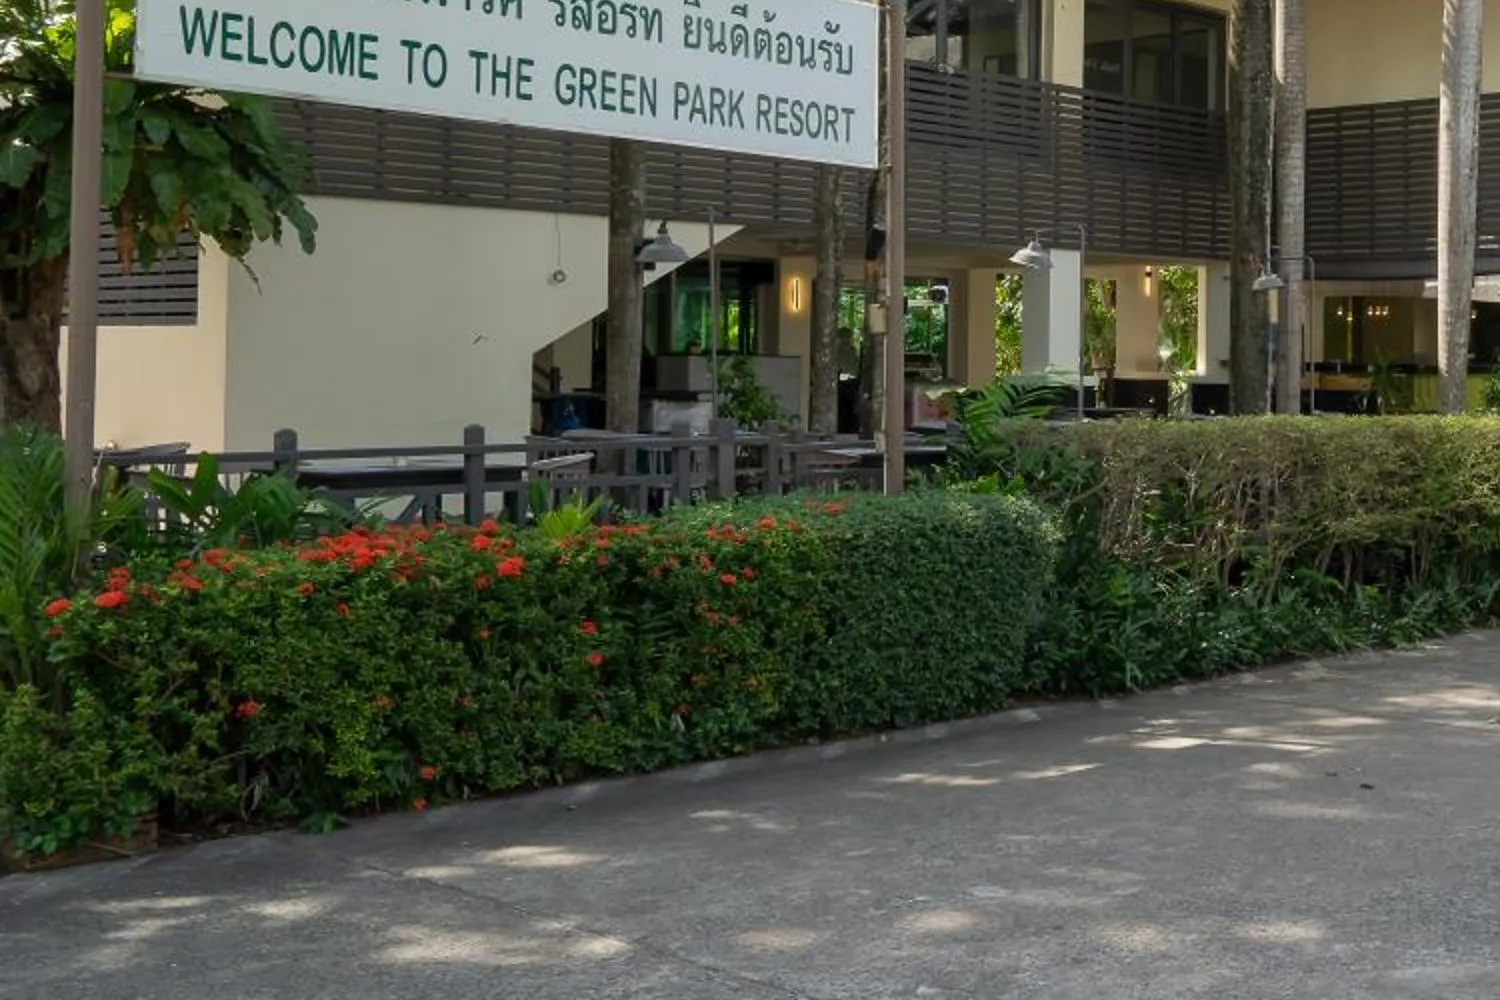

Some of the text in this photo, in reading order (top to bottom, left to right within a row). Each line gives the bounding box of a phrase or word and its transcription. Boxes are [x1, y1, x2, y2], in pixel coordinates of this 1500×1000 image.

[179, 4, 856, 143] WELCOME TO THE GREEN PARK RESORT
